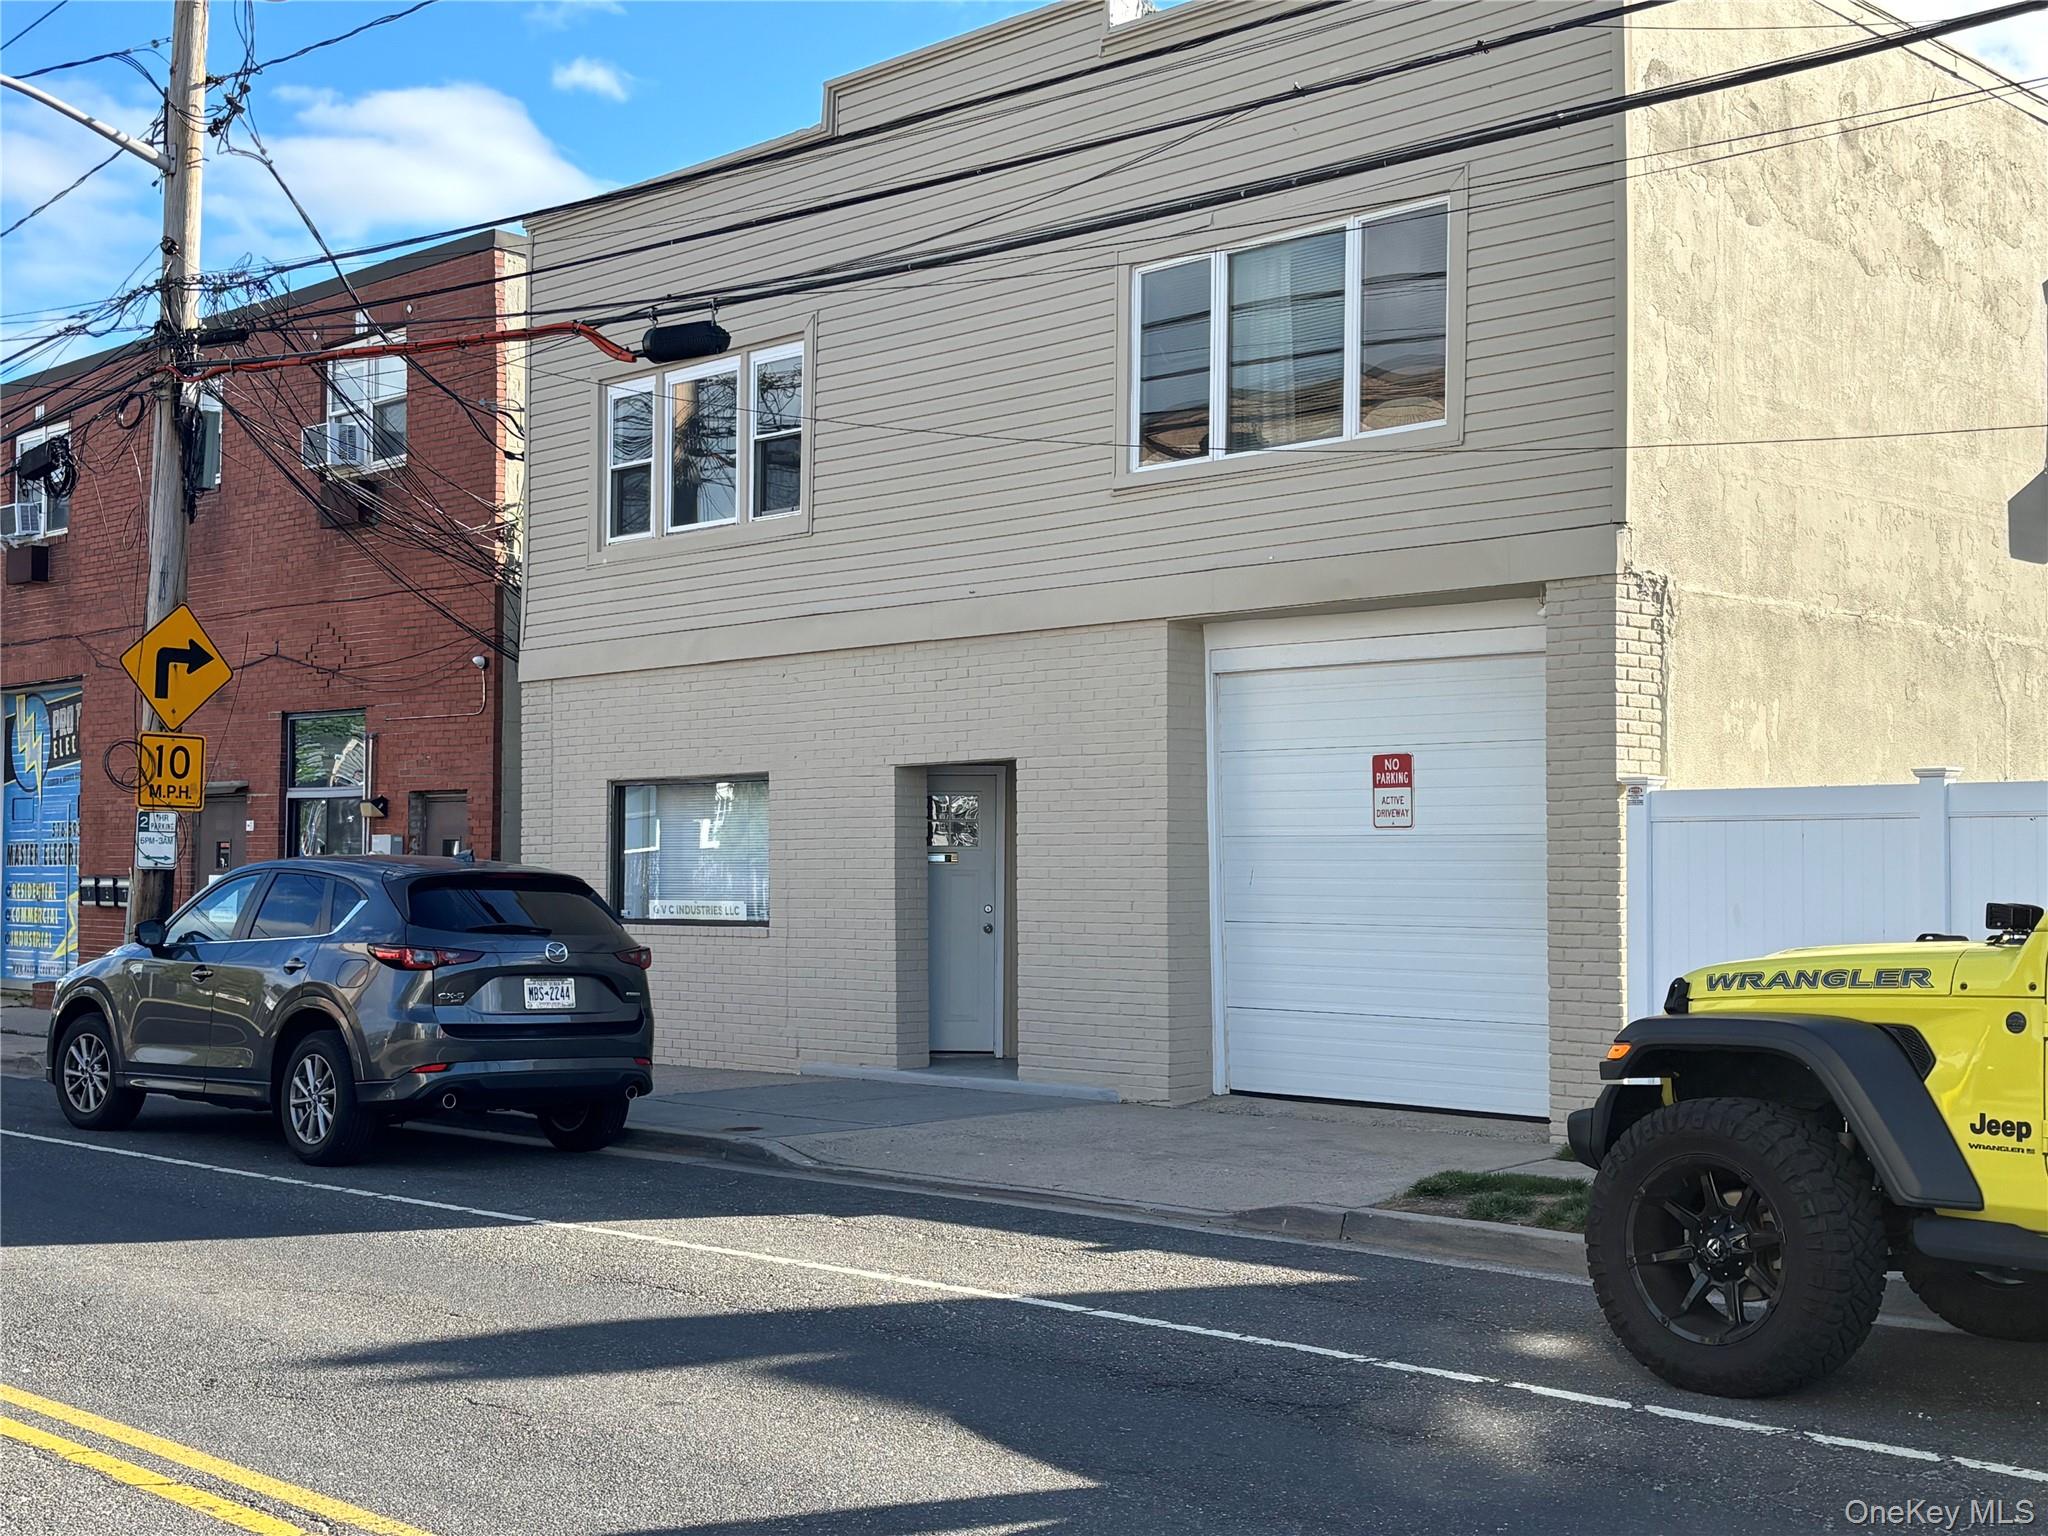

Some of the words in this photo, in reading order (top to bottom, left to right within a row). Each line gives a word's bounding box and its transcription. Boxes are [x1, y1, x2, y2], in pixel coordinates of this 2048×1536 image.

[156, 744, 191, 780] 10
[1384, 758, 1400, 771] NO
[1376, 771, 1409, 785] PARKING
[148, 784, 192, 800] M.P.H.
[1381, 795, 1405, 806] ACTIVE
[1376, 807, 1410, 818] DRIVEWAY
[139, 816, 149, 828] 2
[150, 822, 176, 831] PARKING
[7, 843, 38, 867] MASTER
[11, 881, 57, 900] RESIDENTIAL
[11, 906, 59, 925] COMMERCIAL
[661, 904, 668, 914] V
[668, 904, 675, 915] C
[676, 904, 722, 916] INDUSTRIES
[724, 905, 740, 916] LLC
[11, 931, 52, 949] INDUSTRIAL
[1707, 968, 1935, 992] WRANGLER
[437, 991, 465, 1000] CX-5
[1969, 1112, 2032, 1143] Jeep
[1968, 1142, 2025, 1154] WRANGLER
